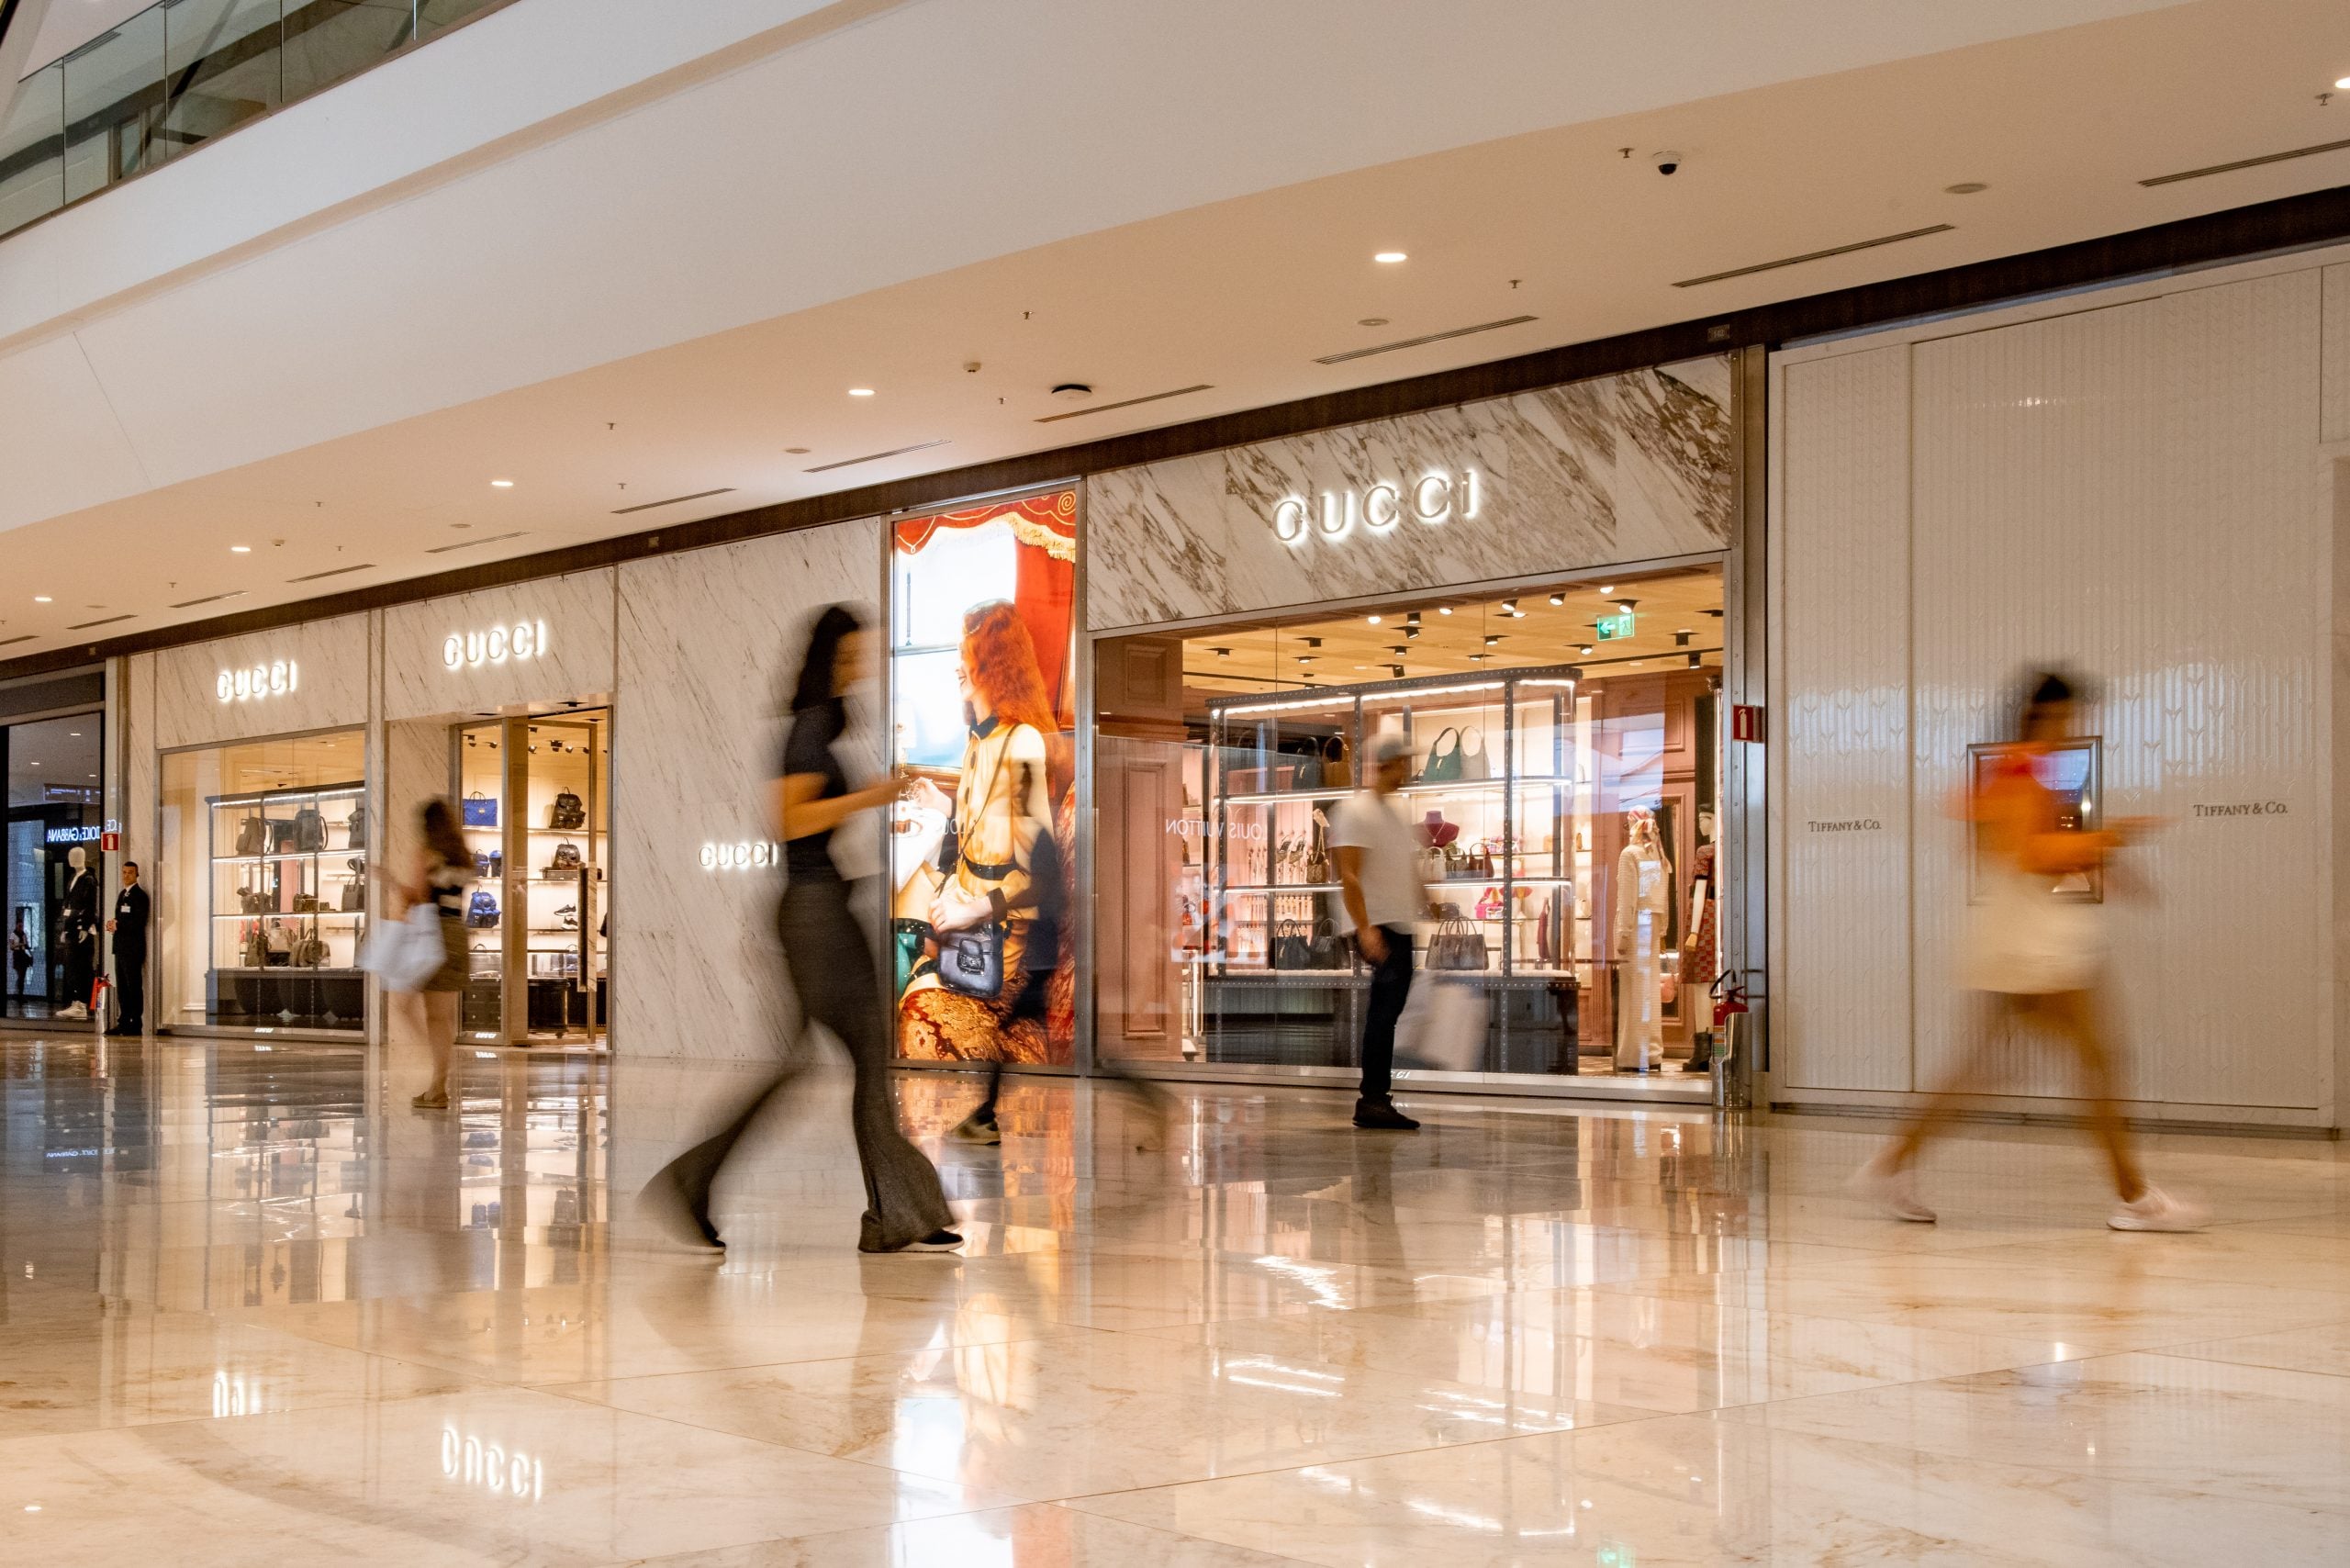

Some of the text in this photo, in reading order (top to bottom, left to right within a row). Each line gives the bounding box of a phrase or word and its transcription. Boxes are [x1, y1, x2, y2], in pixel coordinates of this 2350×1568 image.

[1272, 471, 1477, 543] GUCCI
[442, 621, 546, 669] GUCCI
[216, 660, 297, 701] GUCCI
[2193, 804, 2250, 816] TIFFANY
[2252, 802, 2263, 814] &
[1807, 821, 1852, 832] TIFFANY
[1853, 820, 1862, 830] &
[699, 843, 778, 868] GUCCI
